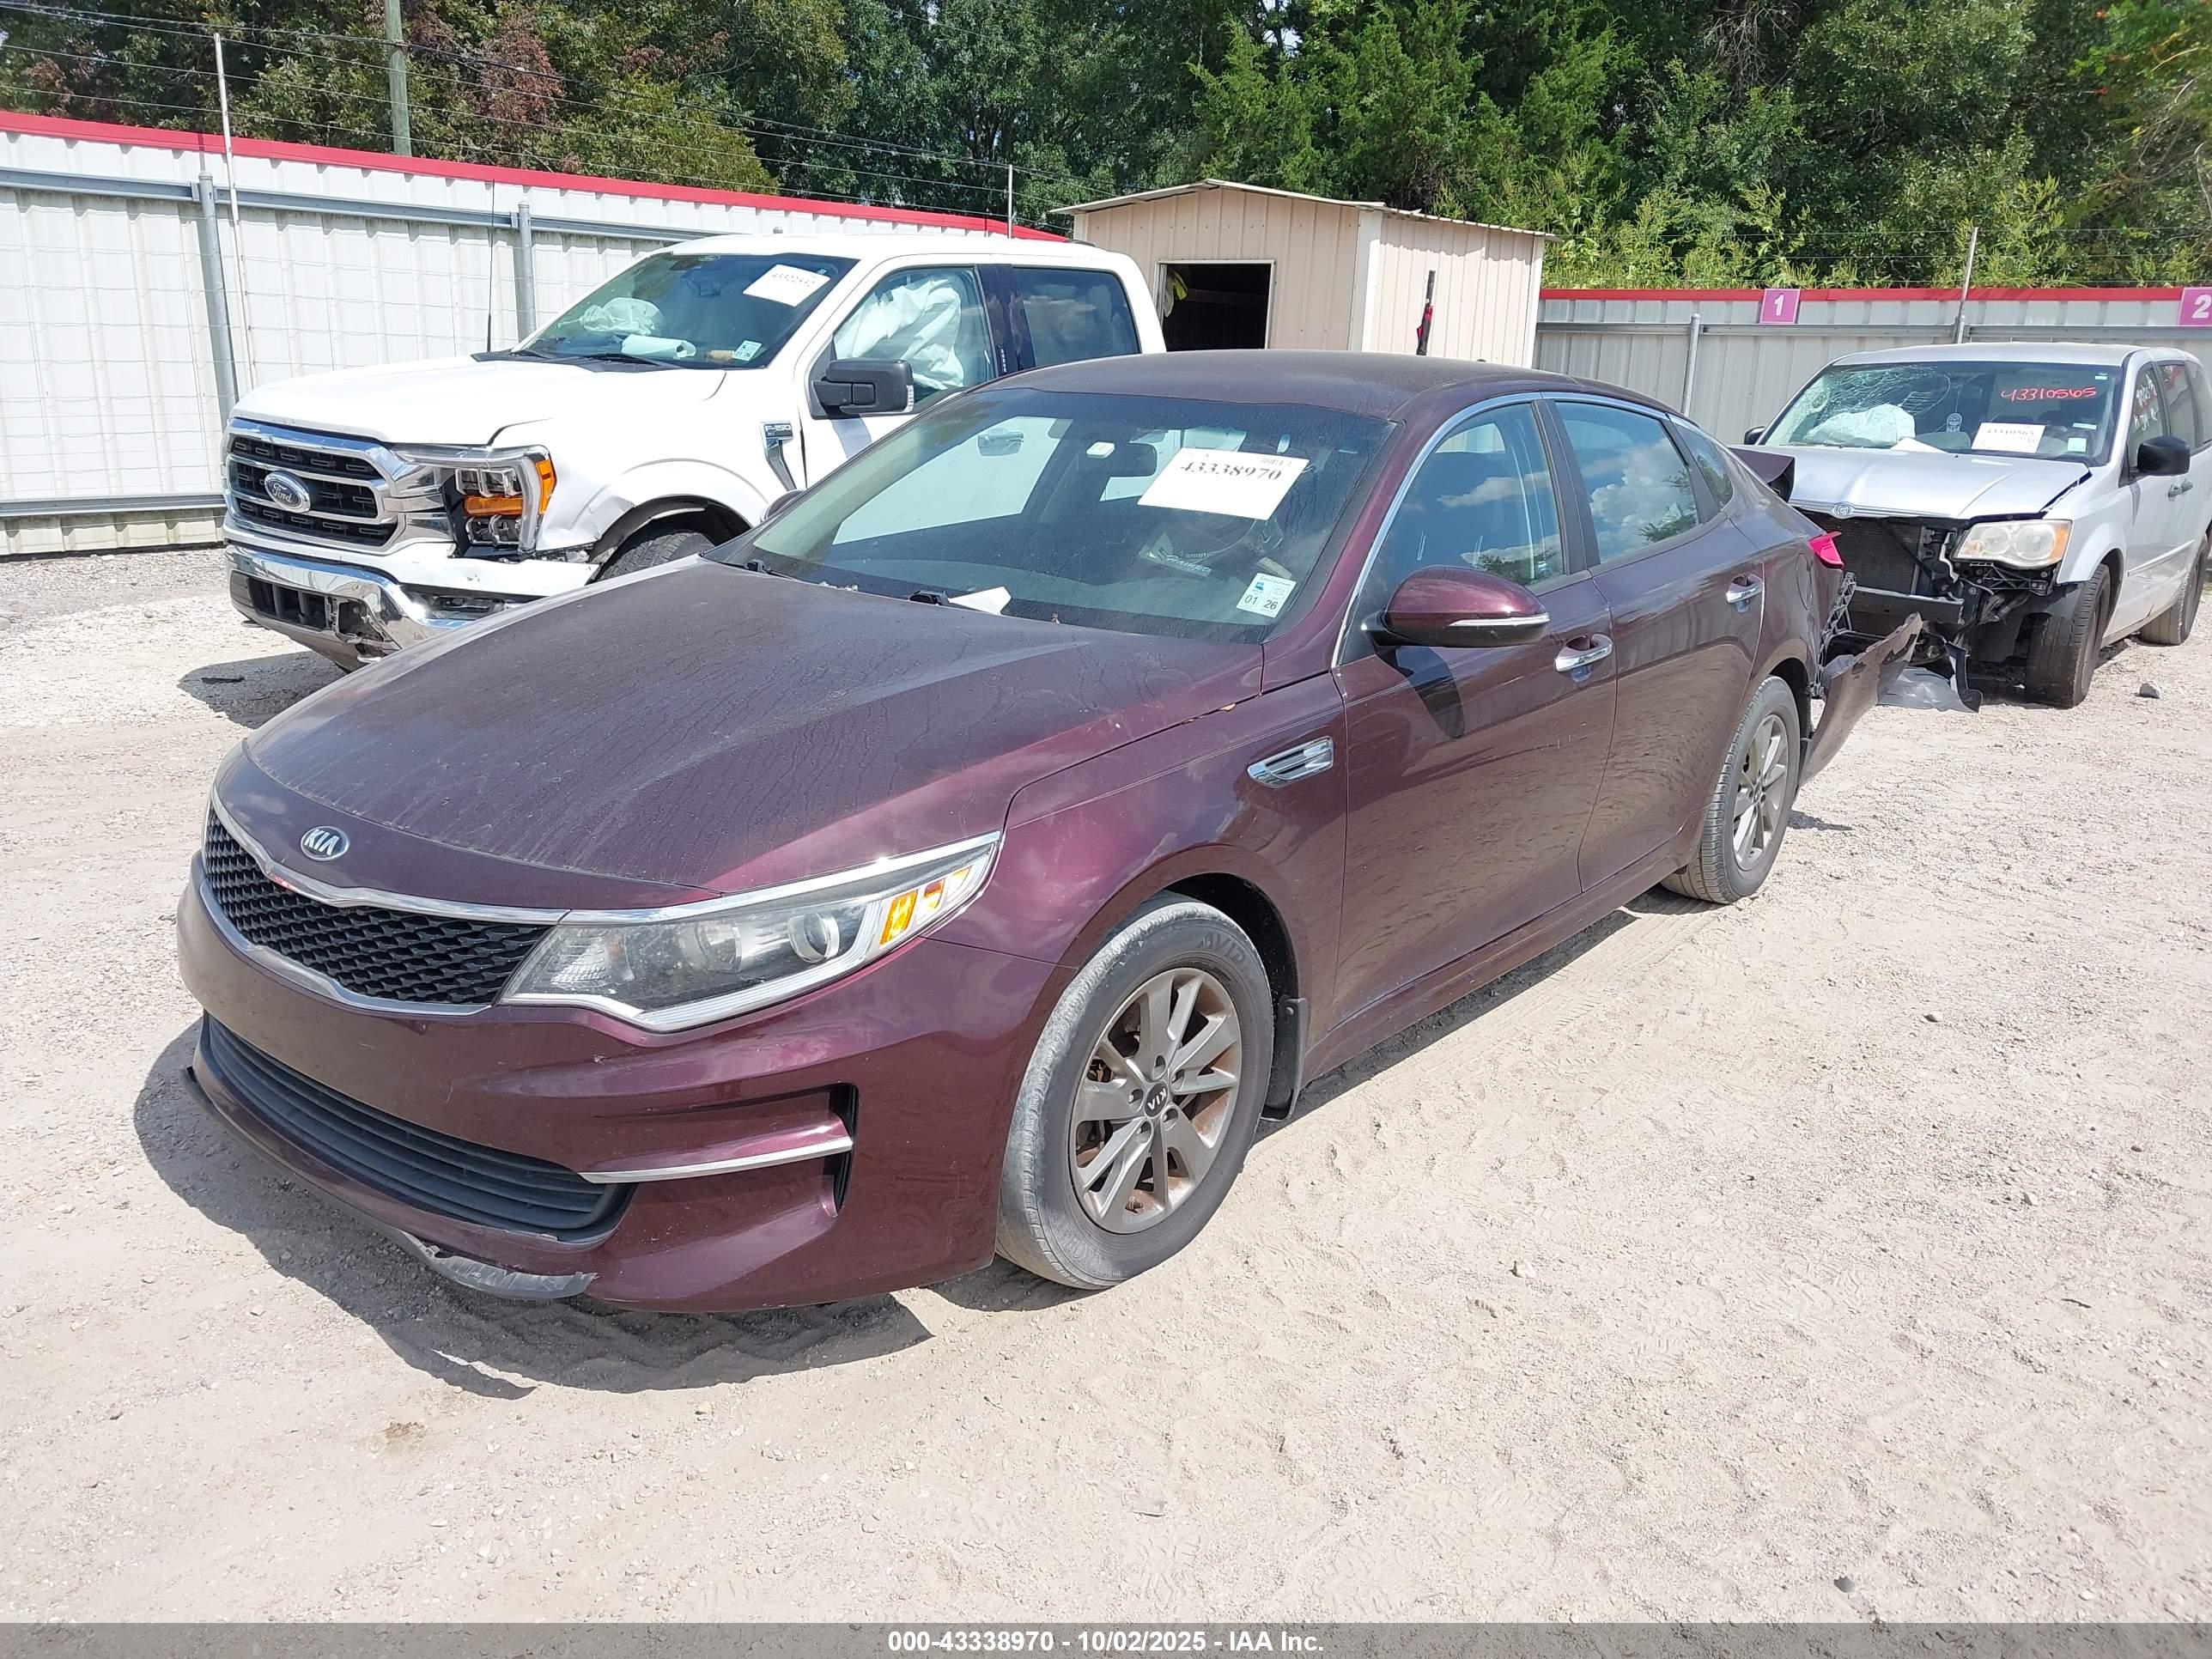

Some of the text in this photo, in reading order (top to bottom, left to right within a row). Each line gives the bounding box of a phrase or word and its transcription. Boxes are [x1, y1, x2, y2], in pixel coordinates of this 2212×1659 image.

[1774, 295, 1784, 316] 1
[2192, 295, 2212, 319] 2
[2000, 386, 2098, 403] 43310565
[1180, 461, 1282, 480] 43338970
[273, 483, 293, 503] Ford
[1243, 594, 1279, 611] 01 26
[304, 829, 339, 856] KIA
[1147, 1087, 1167, 1110] KIA
